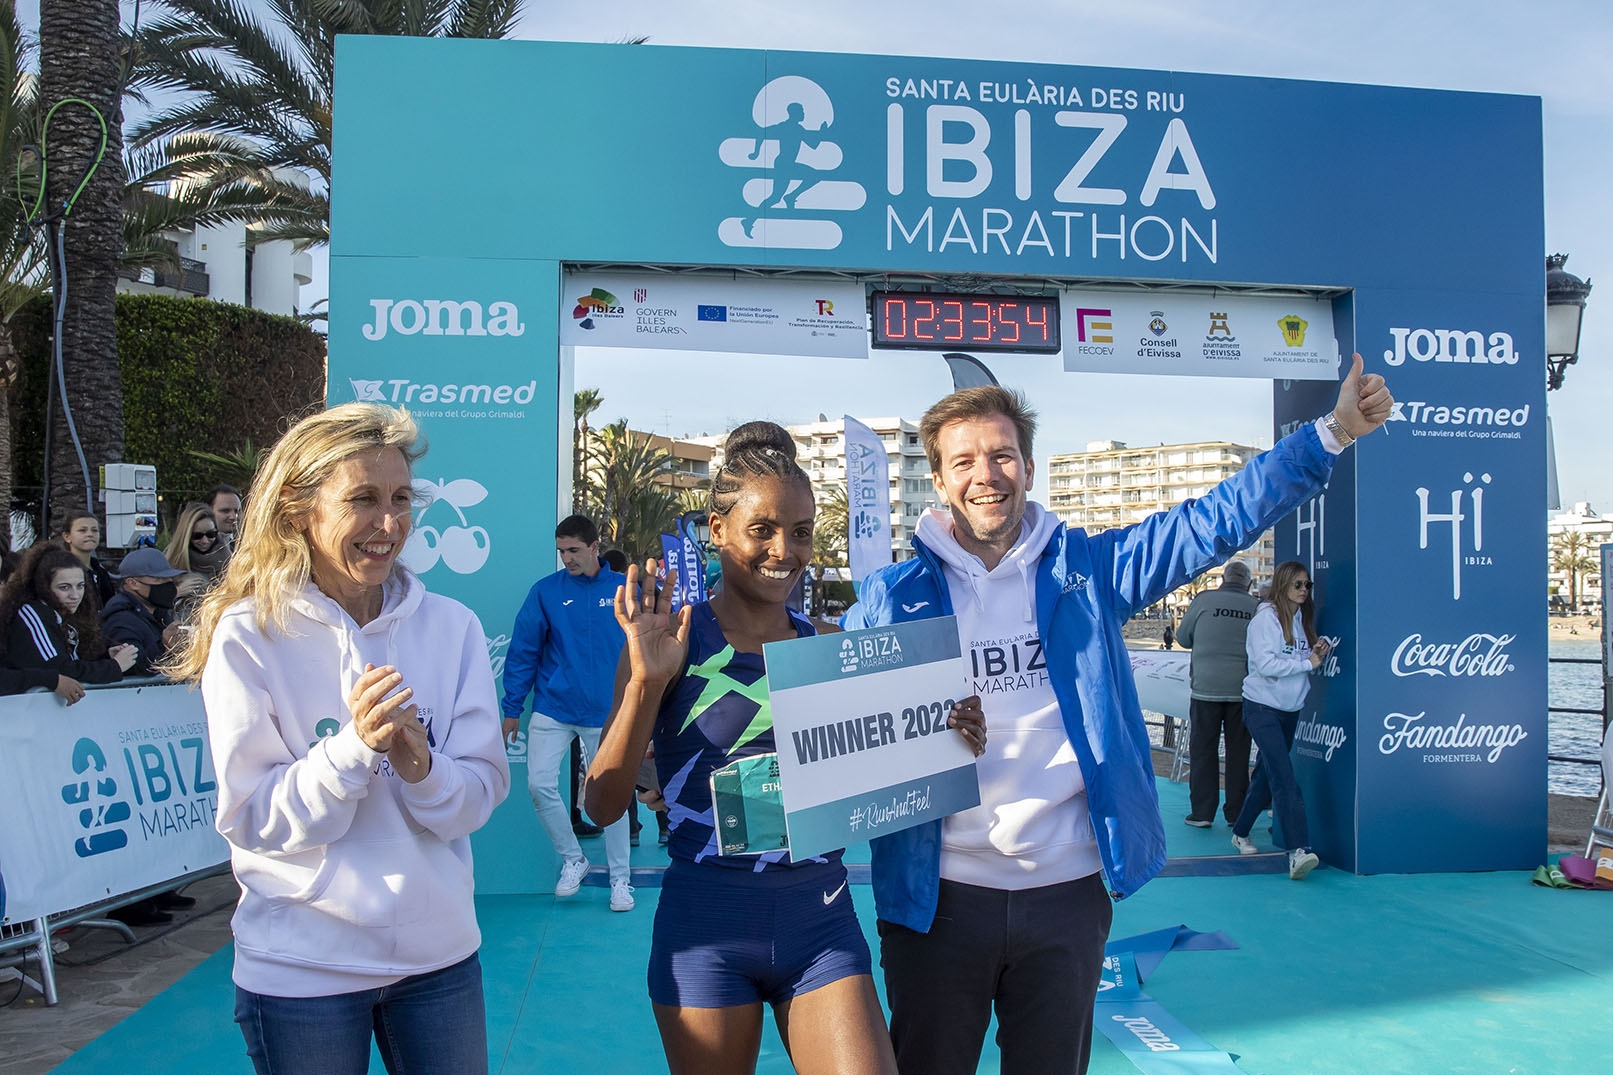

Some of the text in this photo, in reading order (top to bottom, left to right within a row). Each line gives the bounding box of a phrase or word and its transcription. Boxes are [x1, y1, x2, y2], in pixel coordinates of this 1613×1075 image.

[886, 77, 1185, 113] SANTA EULÀRIA DES RIU
[886, 102, 1216, 210] IBIZA
[886, 204, 1217, 264] MARATHON
[592, 304, 625, 314] Ibiza
[636, 308, 677, 317] GOVERN
[885, 299, 1048, 342] 02:33:54
[637, 317, 666, 325] ILLES
[1078, 346, 1115, 355] FECOEV
[1137, 347, 1182, 359] d'Eivissa
[1140, 337, 1178, 347] Consell
[387, 379, 537, 405] Trasmed
[411, 409, 525, 420] naviera del Grupo Grimaldi
[1407, 401, 1530, 427] Trasmed
[1412, 429, 1521, 440] Una naviera del Grupo Grimaldi
[1465, 556, 1493, 565] IBIZA
[858, 635, 902, 659] IBIZA
[970, 640, 997, 648] SANTA
[859, 654, 904, 670] MARATHON
[970, 639, 1046, 678] IBIZ
[973, 672, 1049, 695] MARATH
[118, 729, 149, 744] SANTA
[186, 722, 204, 735] DES
[792, 712, 897, 766] WINNER
[1378, 711, 1528, 763] Fandango
[1423, 754, 1482, 763] FORMENTERA
[123, 737, 217, 806] IBIZ
[139, 797, 218, 841] MARATH
[1111, 956, 1124, 988] DES RIU
